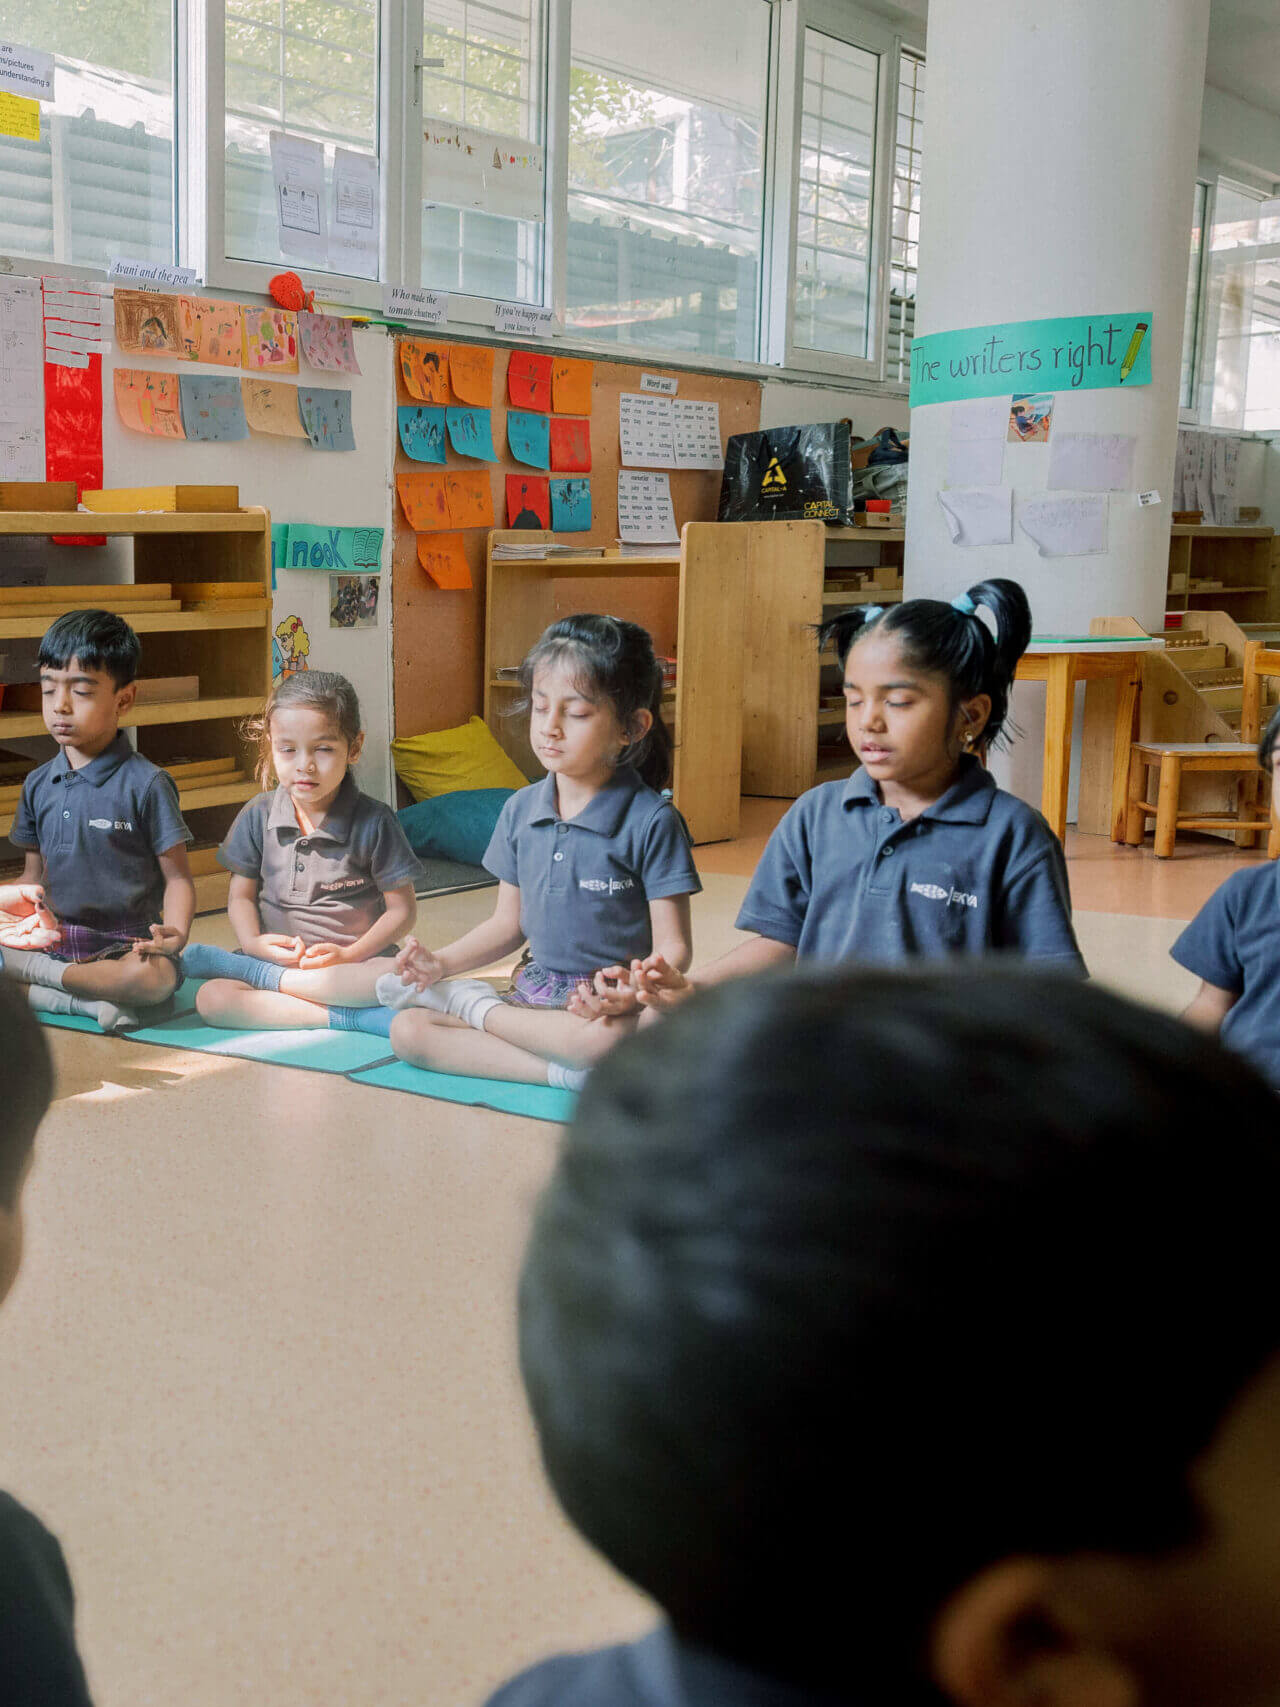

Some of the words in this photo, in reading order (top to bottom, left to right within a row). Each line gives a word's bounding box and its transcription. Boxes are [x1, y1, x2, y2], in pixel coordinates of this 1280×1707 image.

[2, 45, 13, 53] are
[0, 68, 45, 88] understanding
[114, 262, 139, 274] Avani
[140, 267, 158, 280] and
[158, 269, 172, 282] the
[172, 275, 189, 286] pea
[392, 289, 411, 300] Who
[426, 294, 438, 305] the
[389, 307, 413, 316] tomato
[913, 346, 940, 384] The
[949, 335, 1043, 378] writers
[1053, 323, 1123, 388] right
[646, 379, 660, 389] Word
[661, 382, 673, 391] wall
[804, 500, 835, 511] CAPITAL
[804, 509, 840, 519] CONNECT
[114, 821, 133, 832] EKYA
[613, 878, 634, 890] EKYA
[952, 891, 978, 909] EKYA
